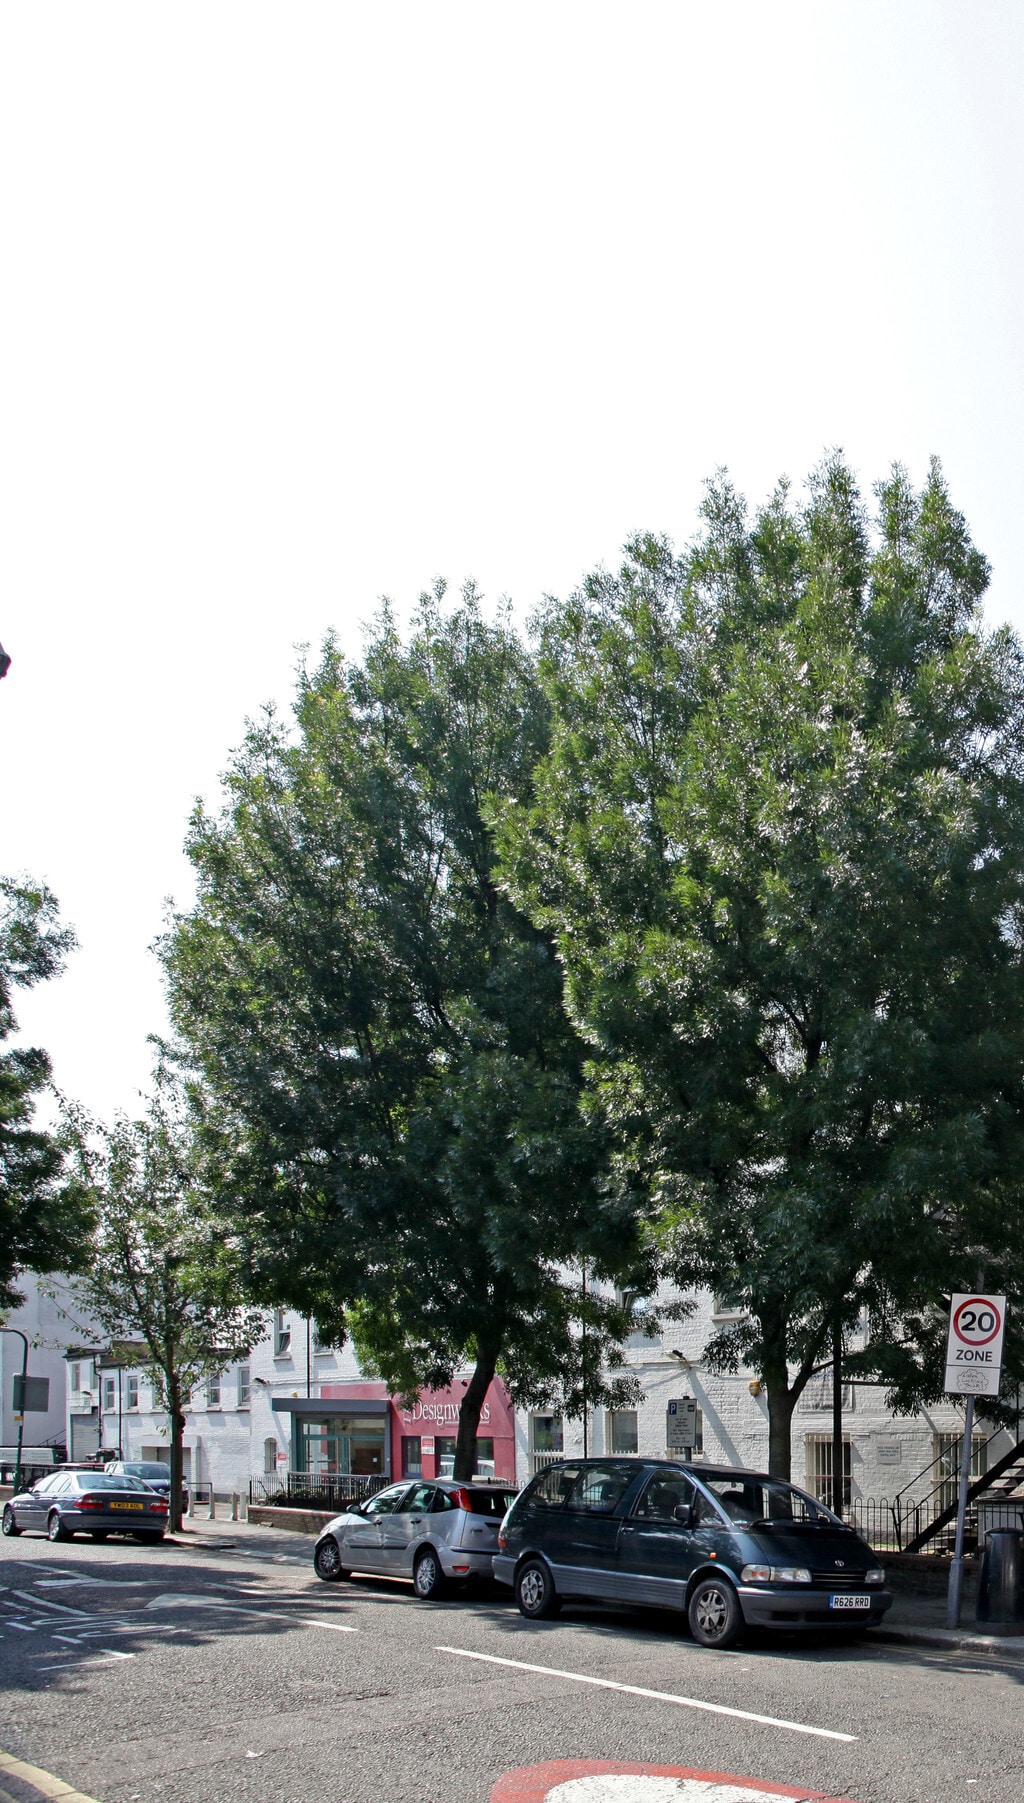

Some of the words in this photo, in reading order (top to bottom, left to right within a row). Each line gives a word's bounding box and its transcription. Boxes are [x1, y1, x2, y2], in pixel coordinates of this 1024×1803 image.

[961, 1310, 995, 1332] 20
[956, 1349, 993, 1362] ZONE
[412, 1396, 490, 1427] Designws
[670, 1403, 676, 1414] P
[834, 1597, 854, 1607] R626
